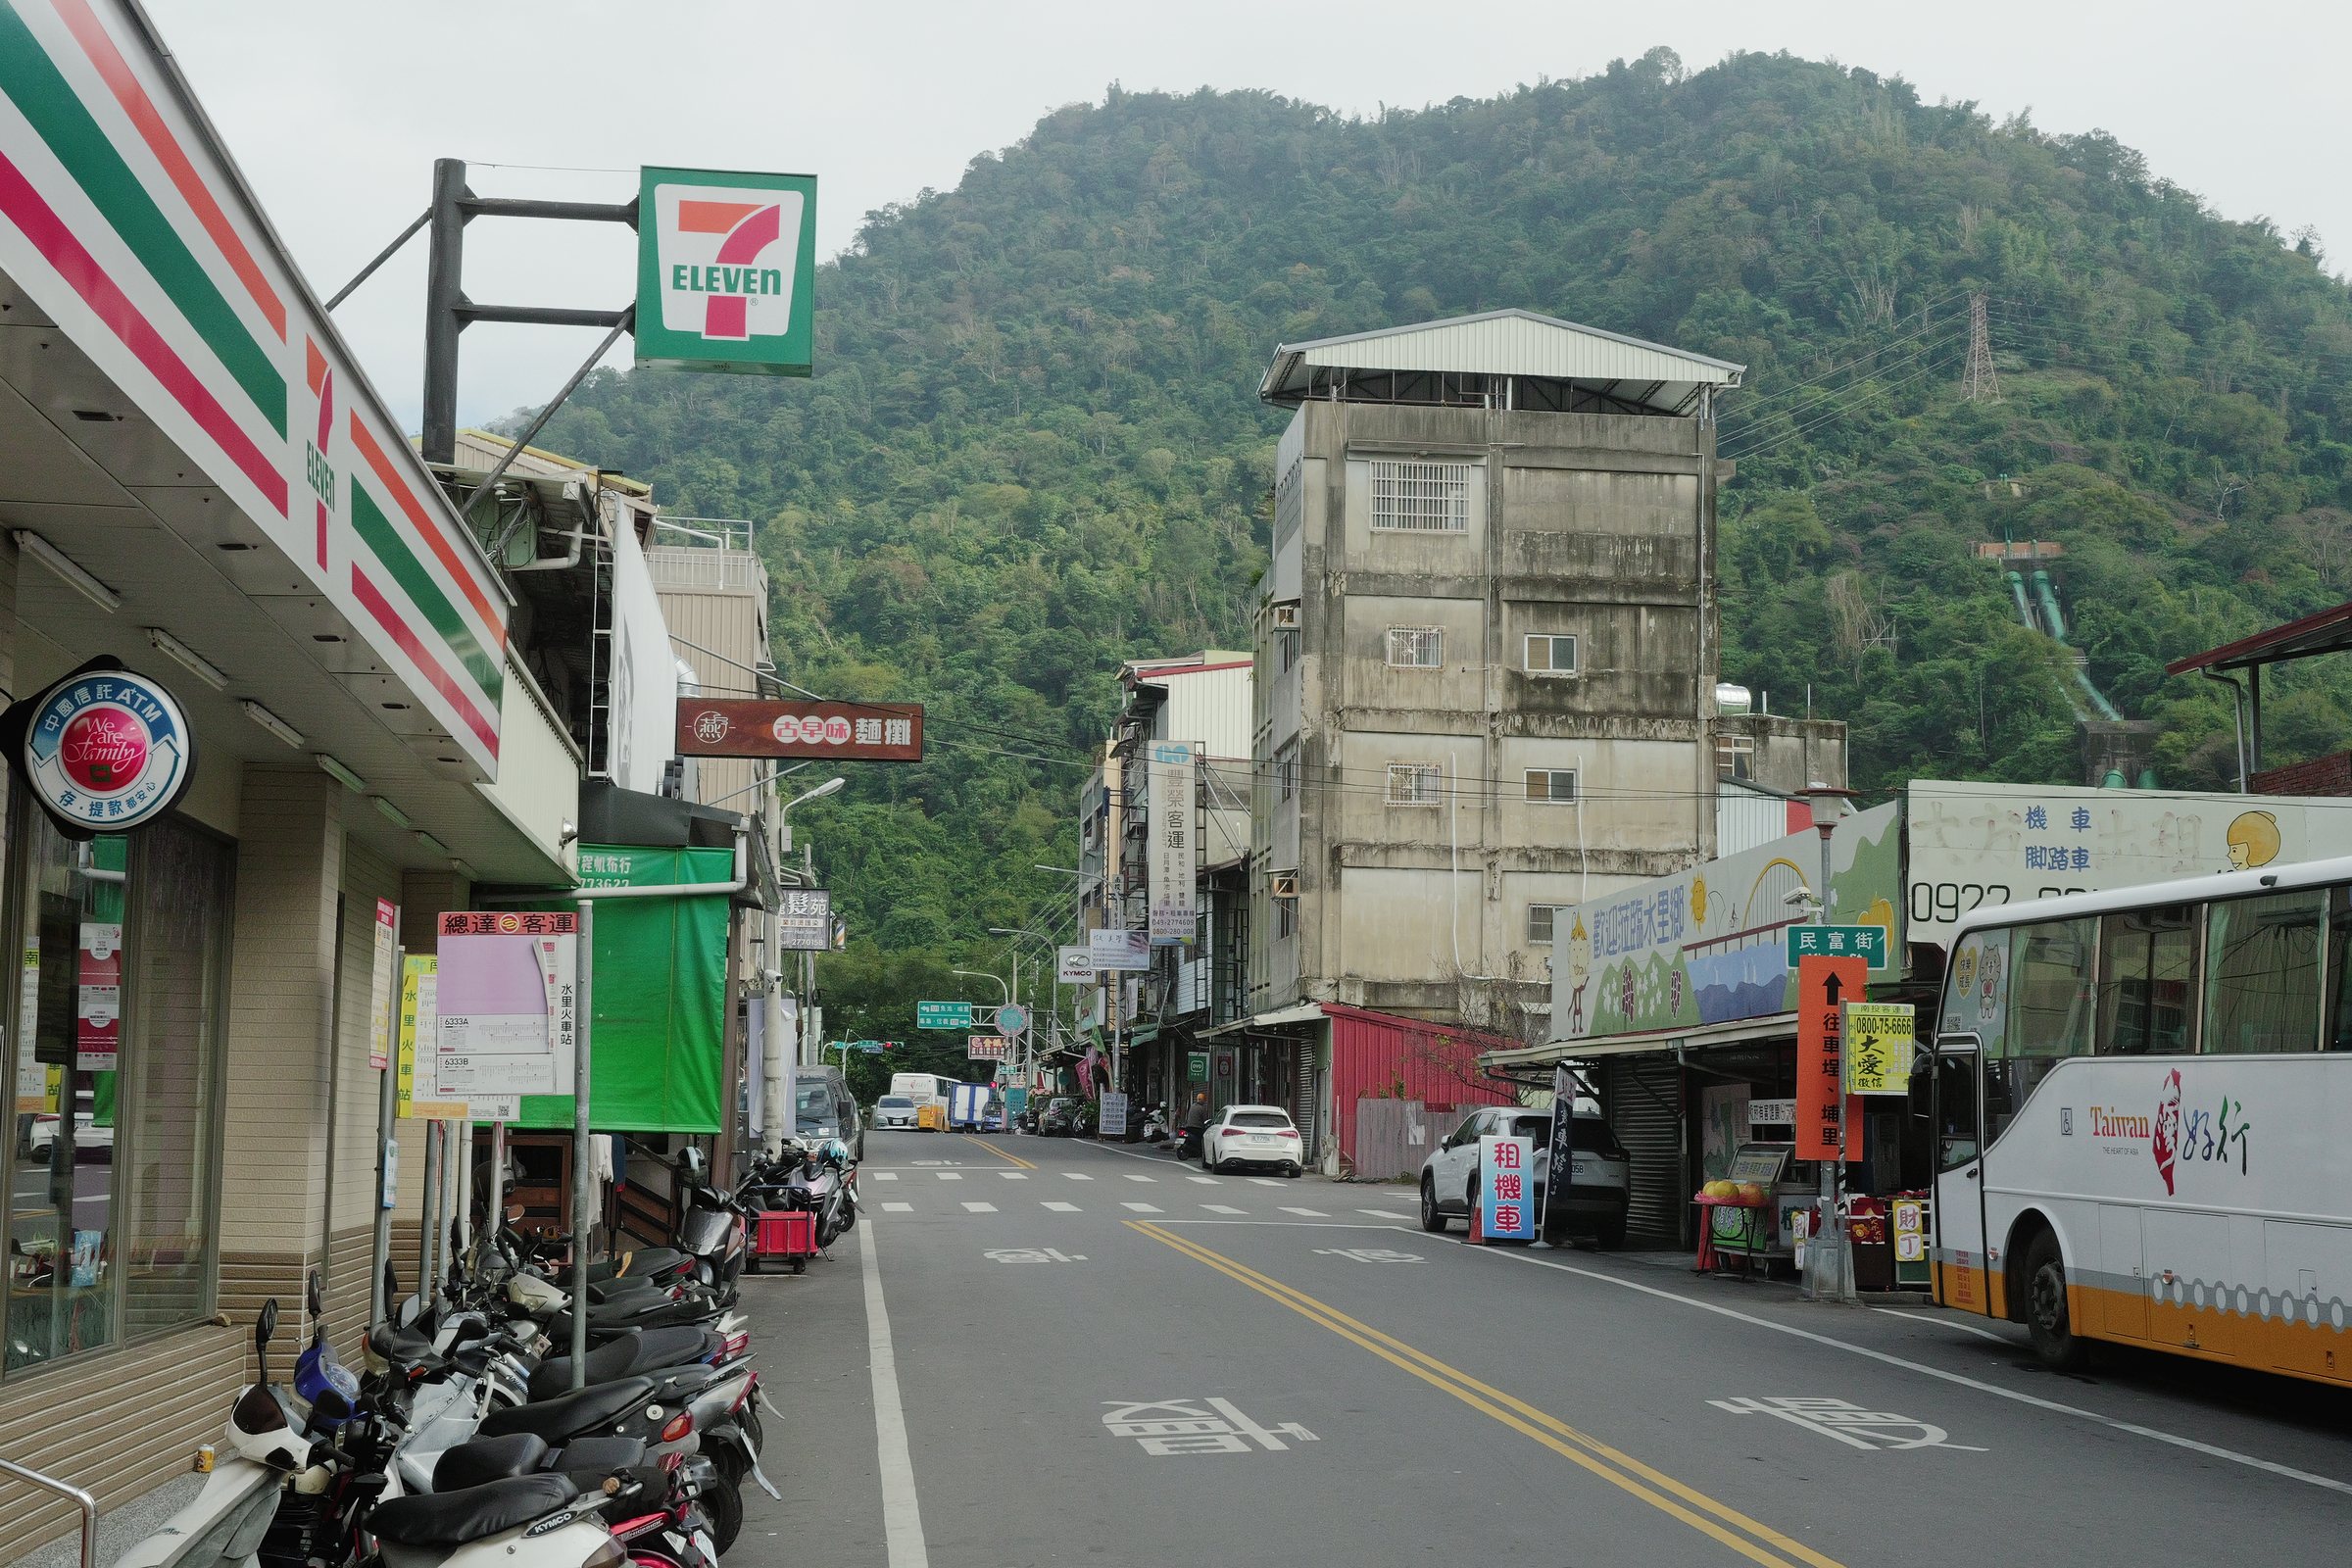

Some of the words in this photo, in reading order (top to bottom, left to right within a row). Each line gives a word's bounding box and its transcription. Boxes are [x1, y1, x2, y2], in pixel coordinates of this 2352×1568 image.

[86, 717, 115, 733] We
[96, 731, 124, 745] are
[1167, 768, 1185, 849] 豐榮客運
[2025, 805, 2091, 833] 機車
[444, 914, 496, 934] 總達
[522, 914, 573, 933] 客運
[1799, 932, 1873, 950] 民富街
[444, 1017, 469, 1026] 6333A
[561, 983, 572, 1045] 水里火車站
[1856, 1016, 1911, 1035] 0800-75-6666
[397, 989, 416, 1102] 水里火車站
[1858, 1034, 1886, 1076] 大愛
[444, 1057, 469, 1066] 6333B
[2090, 1106, 2150, 1138] Taiwan
[1494, 1142, 1522, 1233] 租機車
[1100, 1396, 1321, 1456] 慢
[1704, 1396, 1990, 1450] 慢
[534, 1512, 571, 1534] KYMCO
